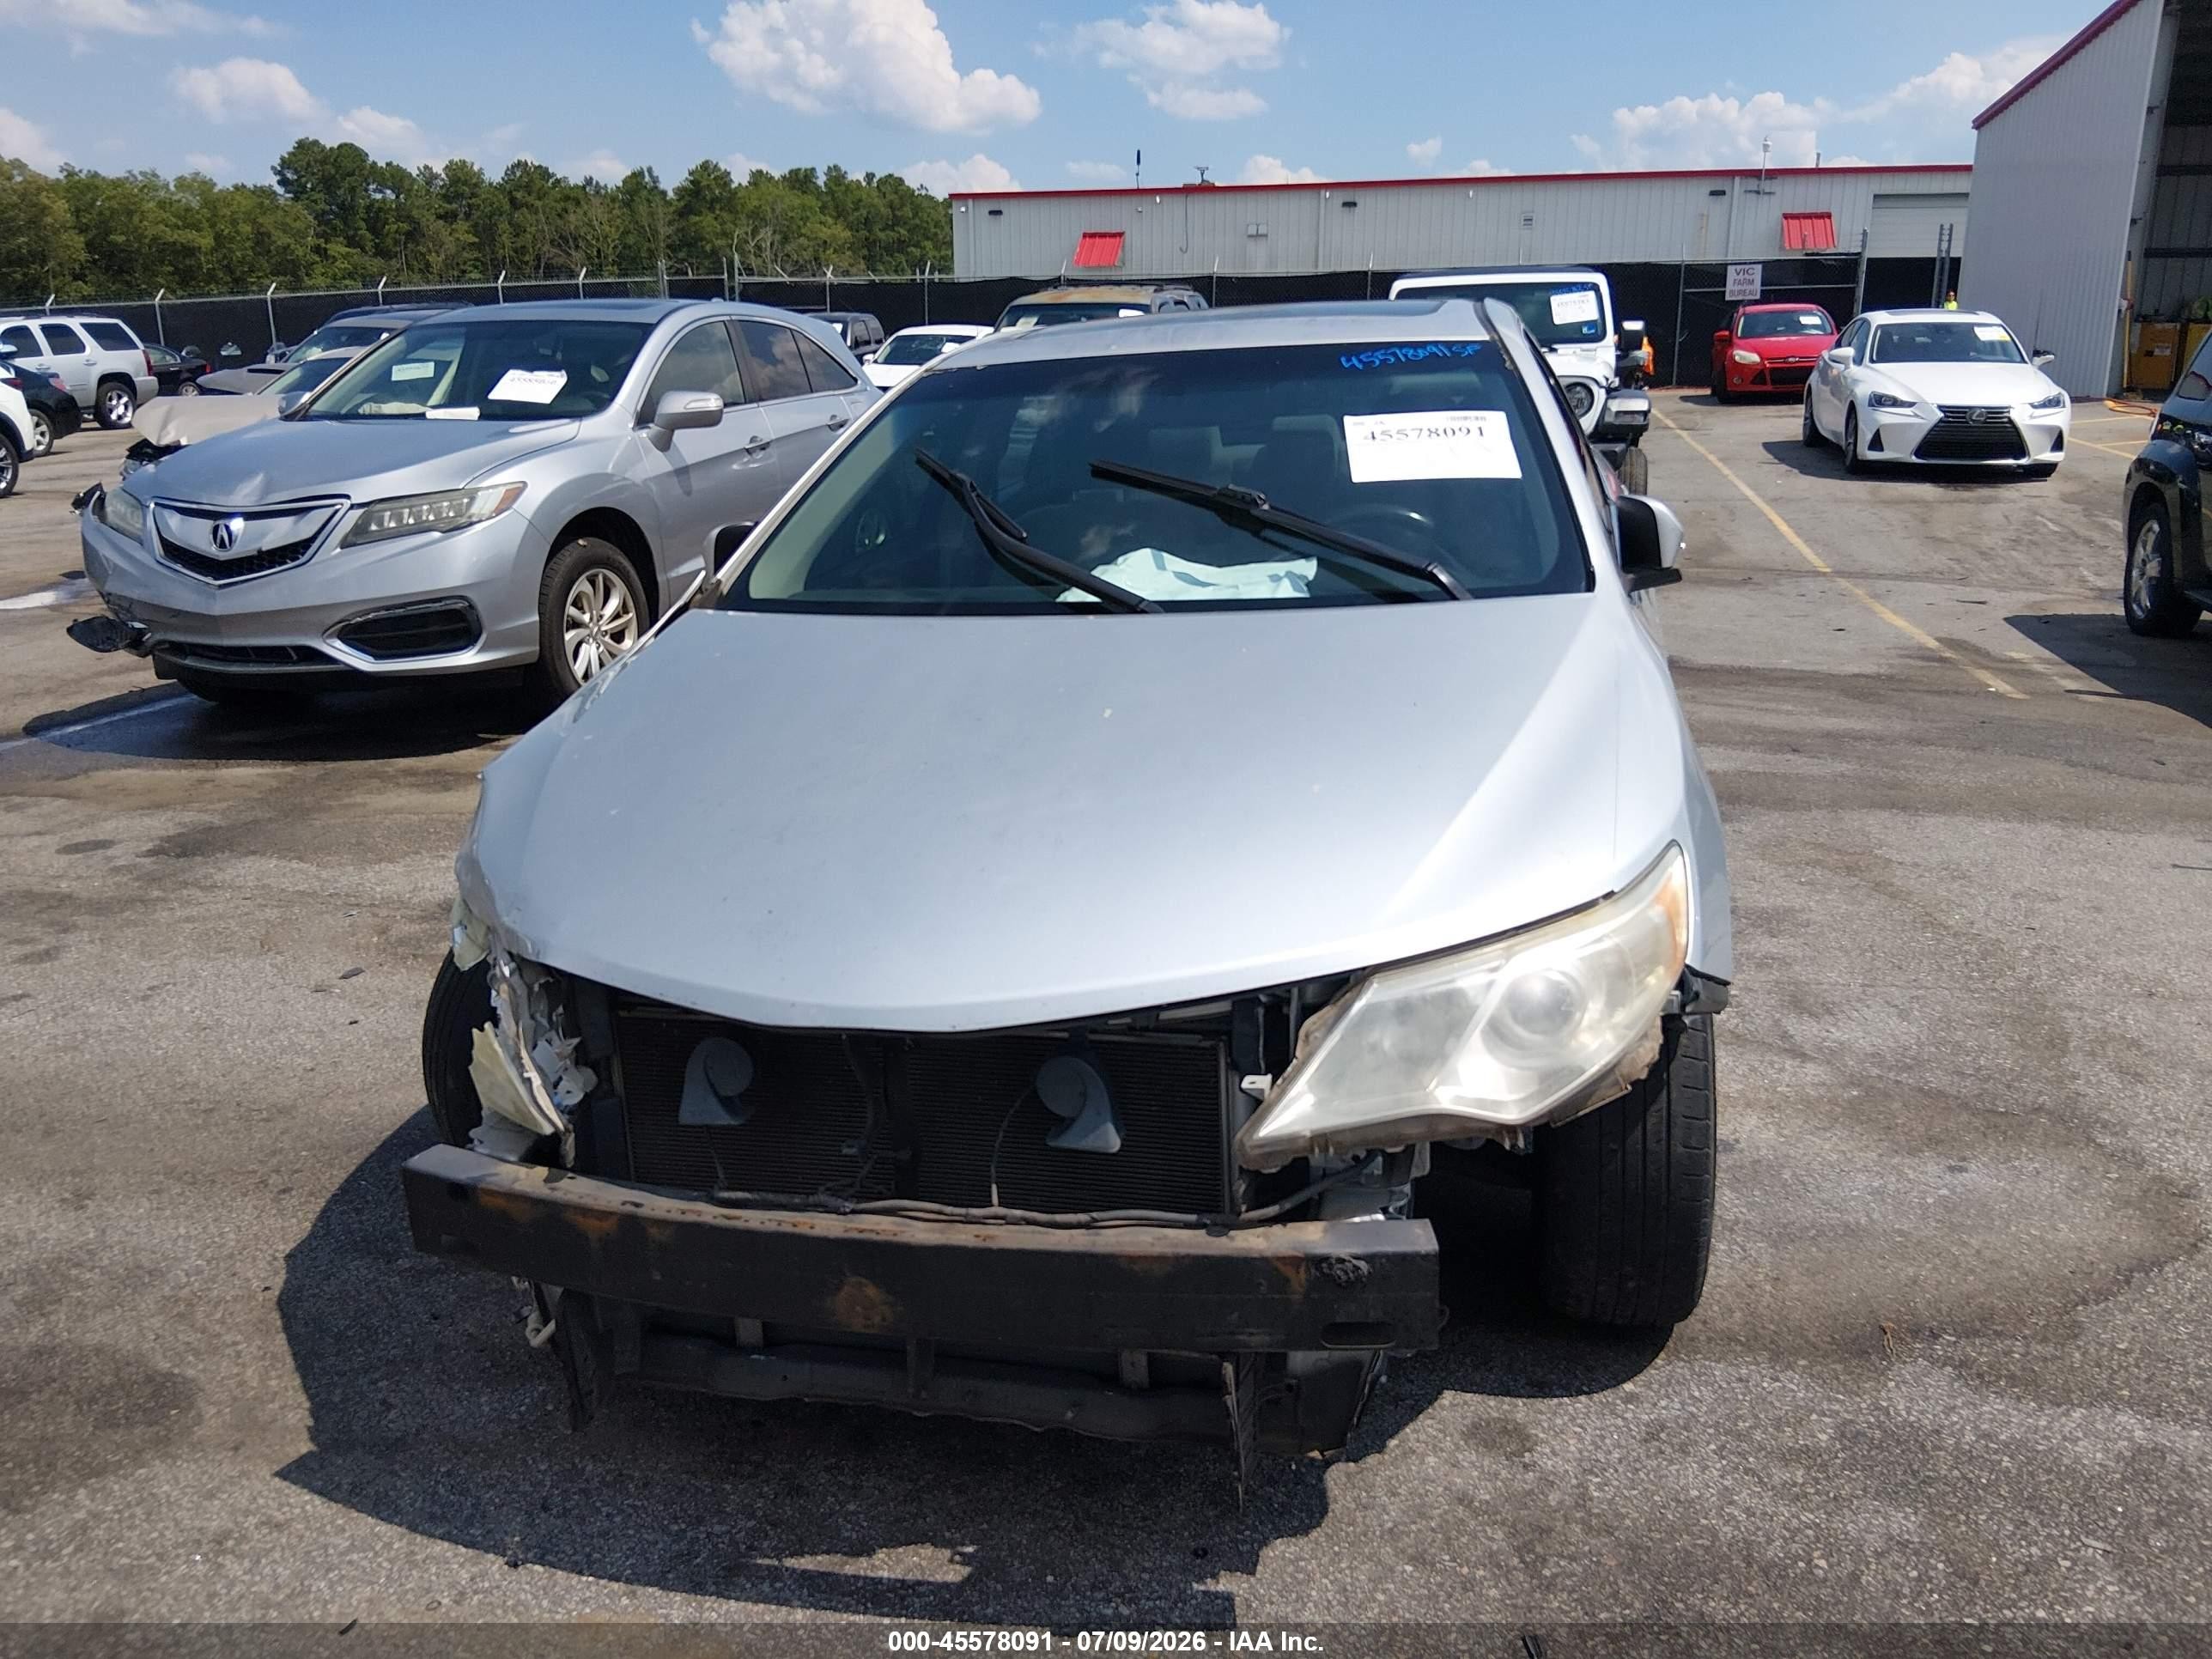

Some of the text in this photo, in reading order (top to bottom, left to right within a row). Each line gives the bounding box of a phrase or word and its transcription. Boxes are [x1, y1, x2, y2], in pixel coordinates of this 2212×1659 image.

[1734, 267, 1756, 276] VIC
[1733, 278, 1754, 287] FARM
[1729, 289, 1758, 298] BUREAU
[1363, 426, 1485, 441] 45578091
